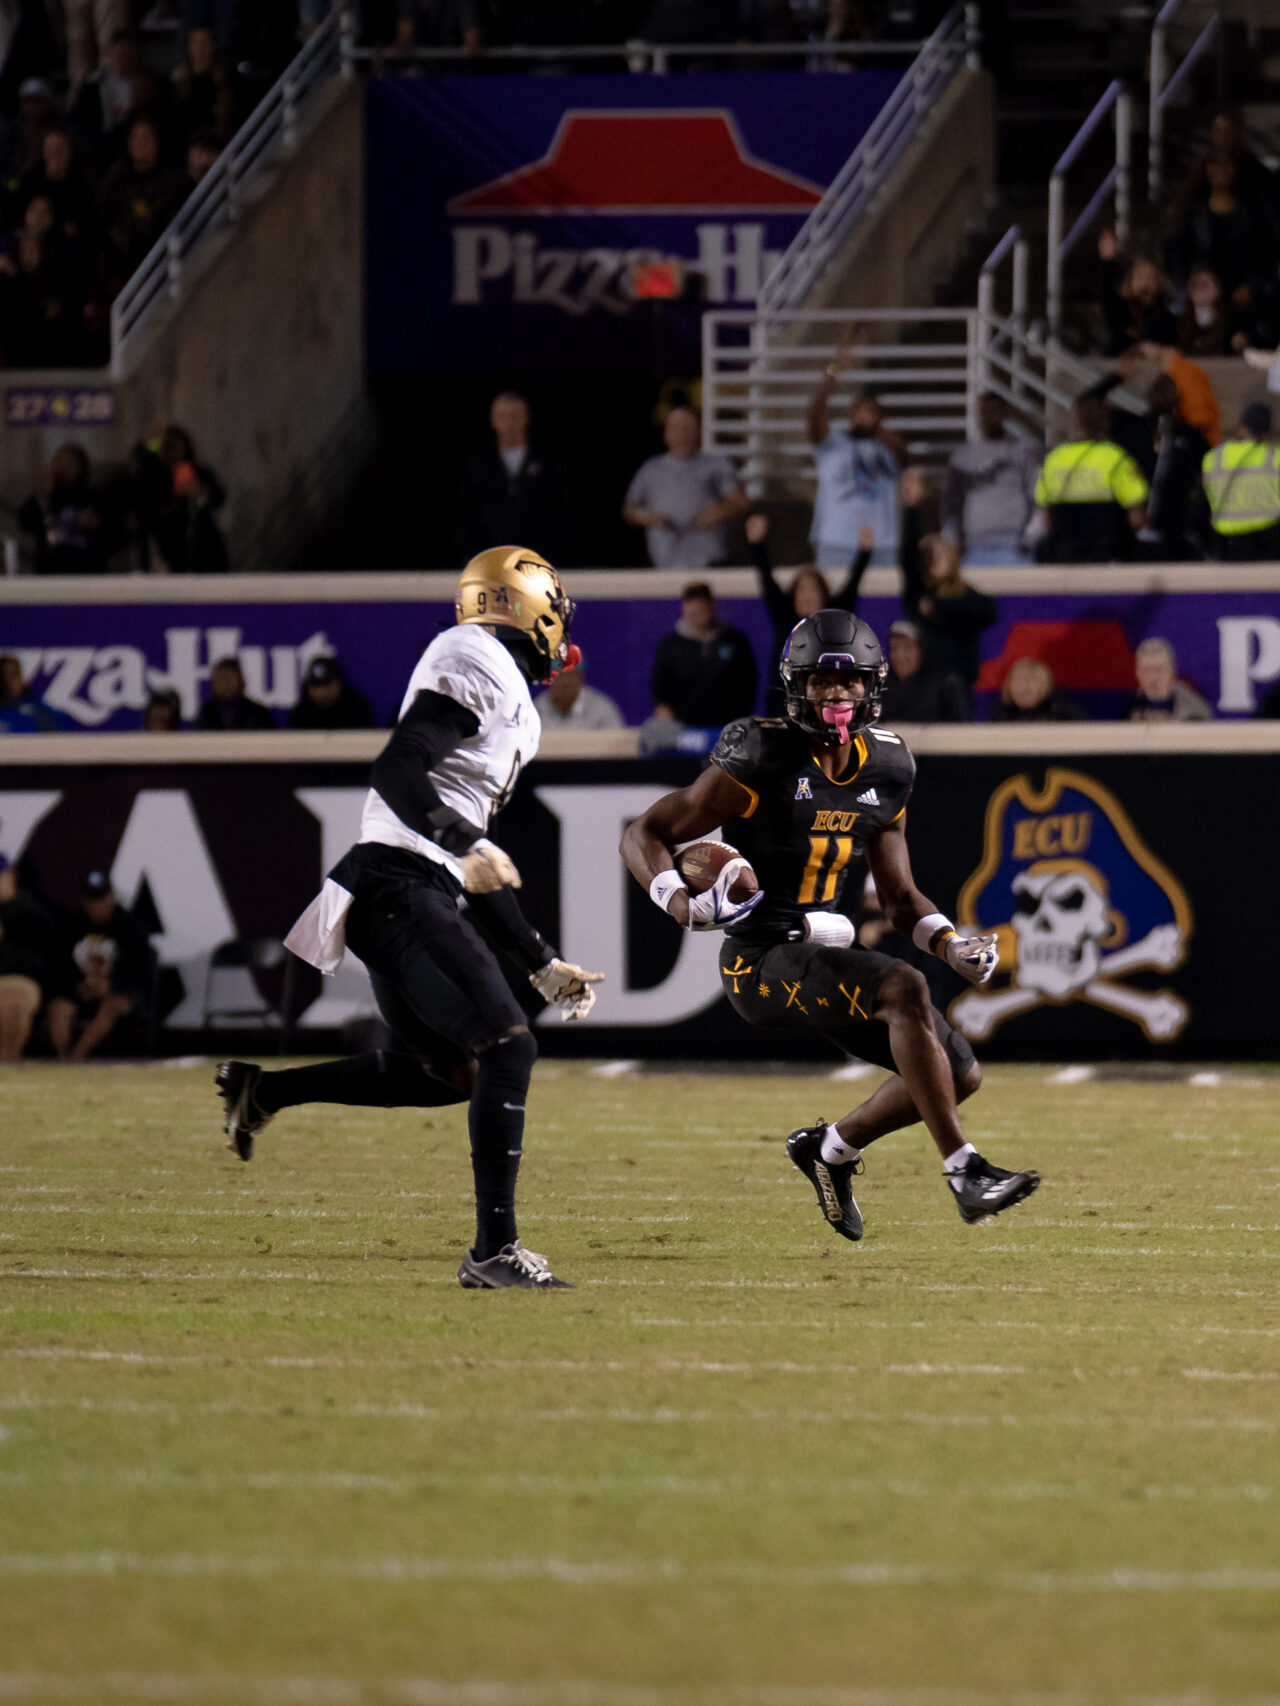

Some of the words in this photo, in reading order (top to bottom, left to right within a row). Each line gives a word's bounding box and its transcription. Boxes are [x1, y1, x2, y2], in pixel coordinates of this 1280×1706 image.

[477, 591, 487, 614] 9
[811, 810, 860, 832] ECU
[1013, 811, 1093, 860] ECU
[797, 834, 854, 905] 11
